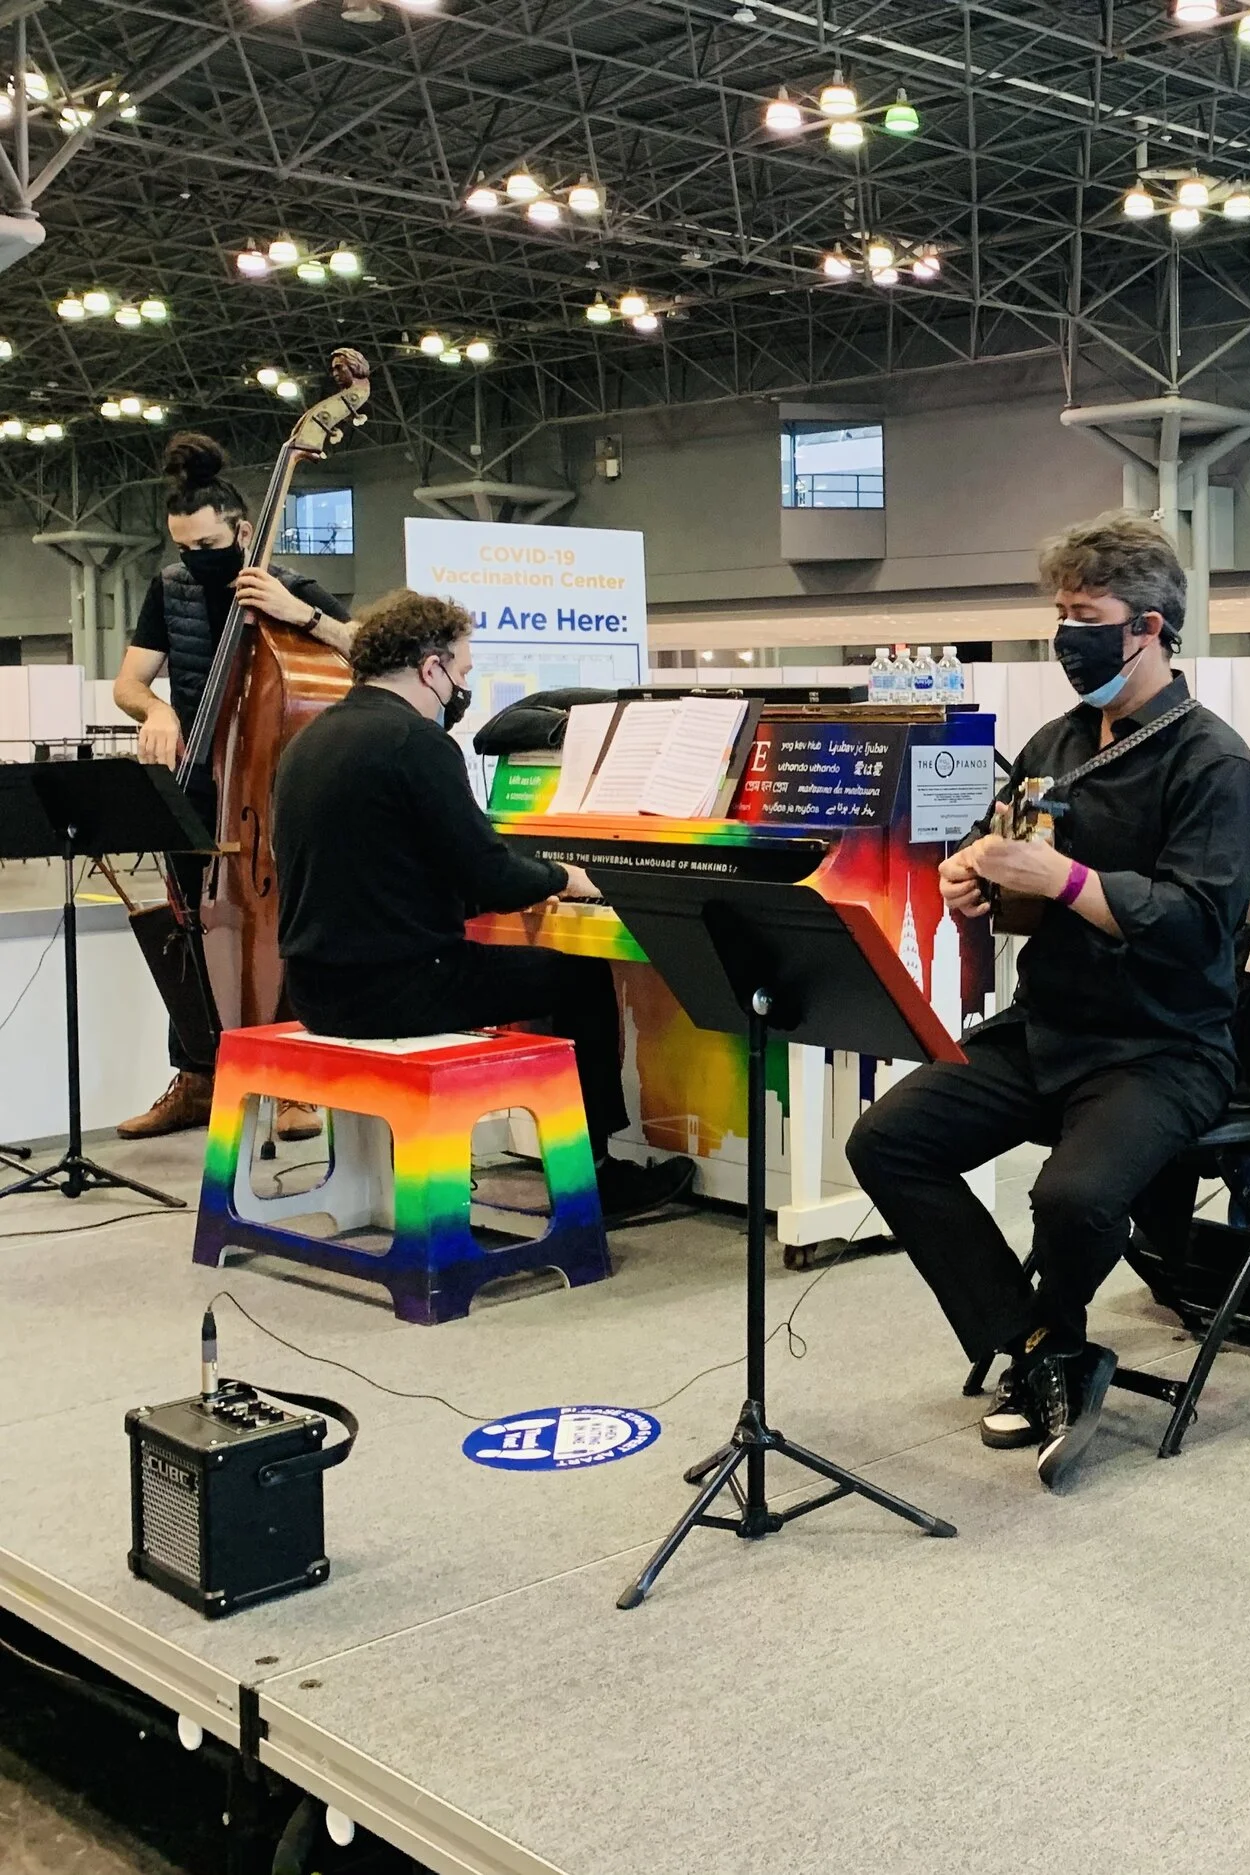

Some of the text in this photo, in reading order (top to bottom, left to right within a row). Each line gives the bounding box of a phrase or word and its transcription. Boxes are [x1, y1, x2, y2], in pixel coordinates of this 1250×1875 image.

[480, 546, 576, 566] COVID-19
[432, 565, 626, 590] Vaccination Center
[497, 606, 547, 630] Are
[557, 608, 628, 633] Here:
[751, 740, 771, 772] E
[828, 740, 855, 756] Ljubav
[918, 760, 933, 769] THE
[956, 759, 987, 769] PIANOS
[542, 850, 727, 873] MUSIC IS THE UNIVERSAL LANGUAGE OF MANKIND
[555, 1450, 615, 1467] APART
